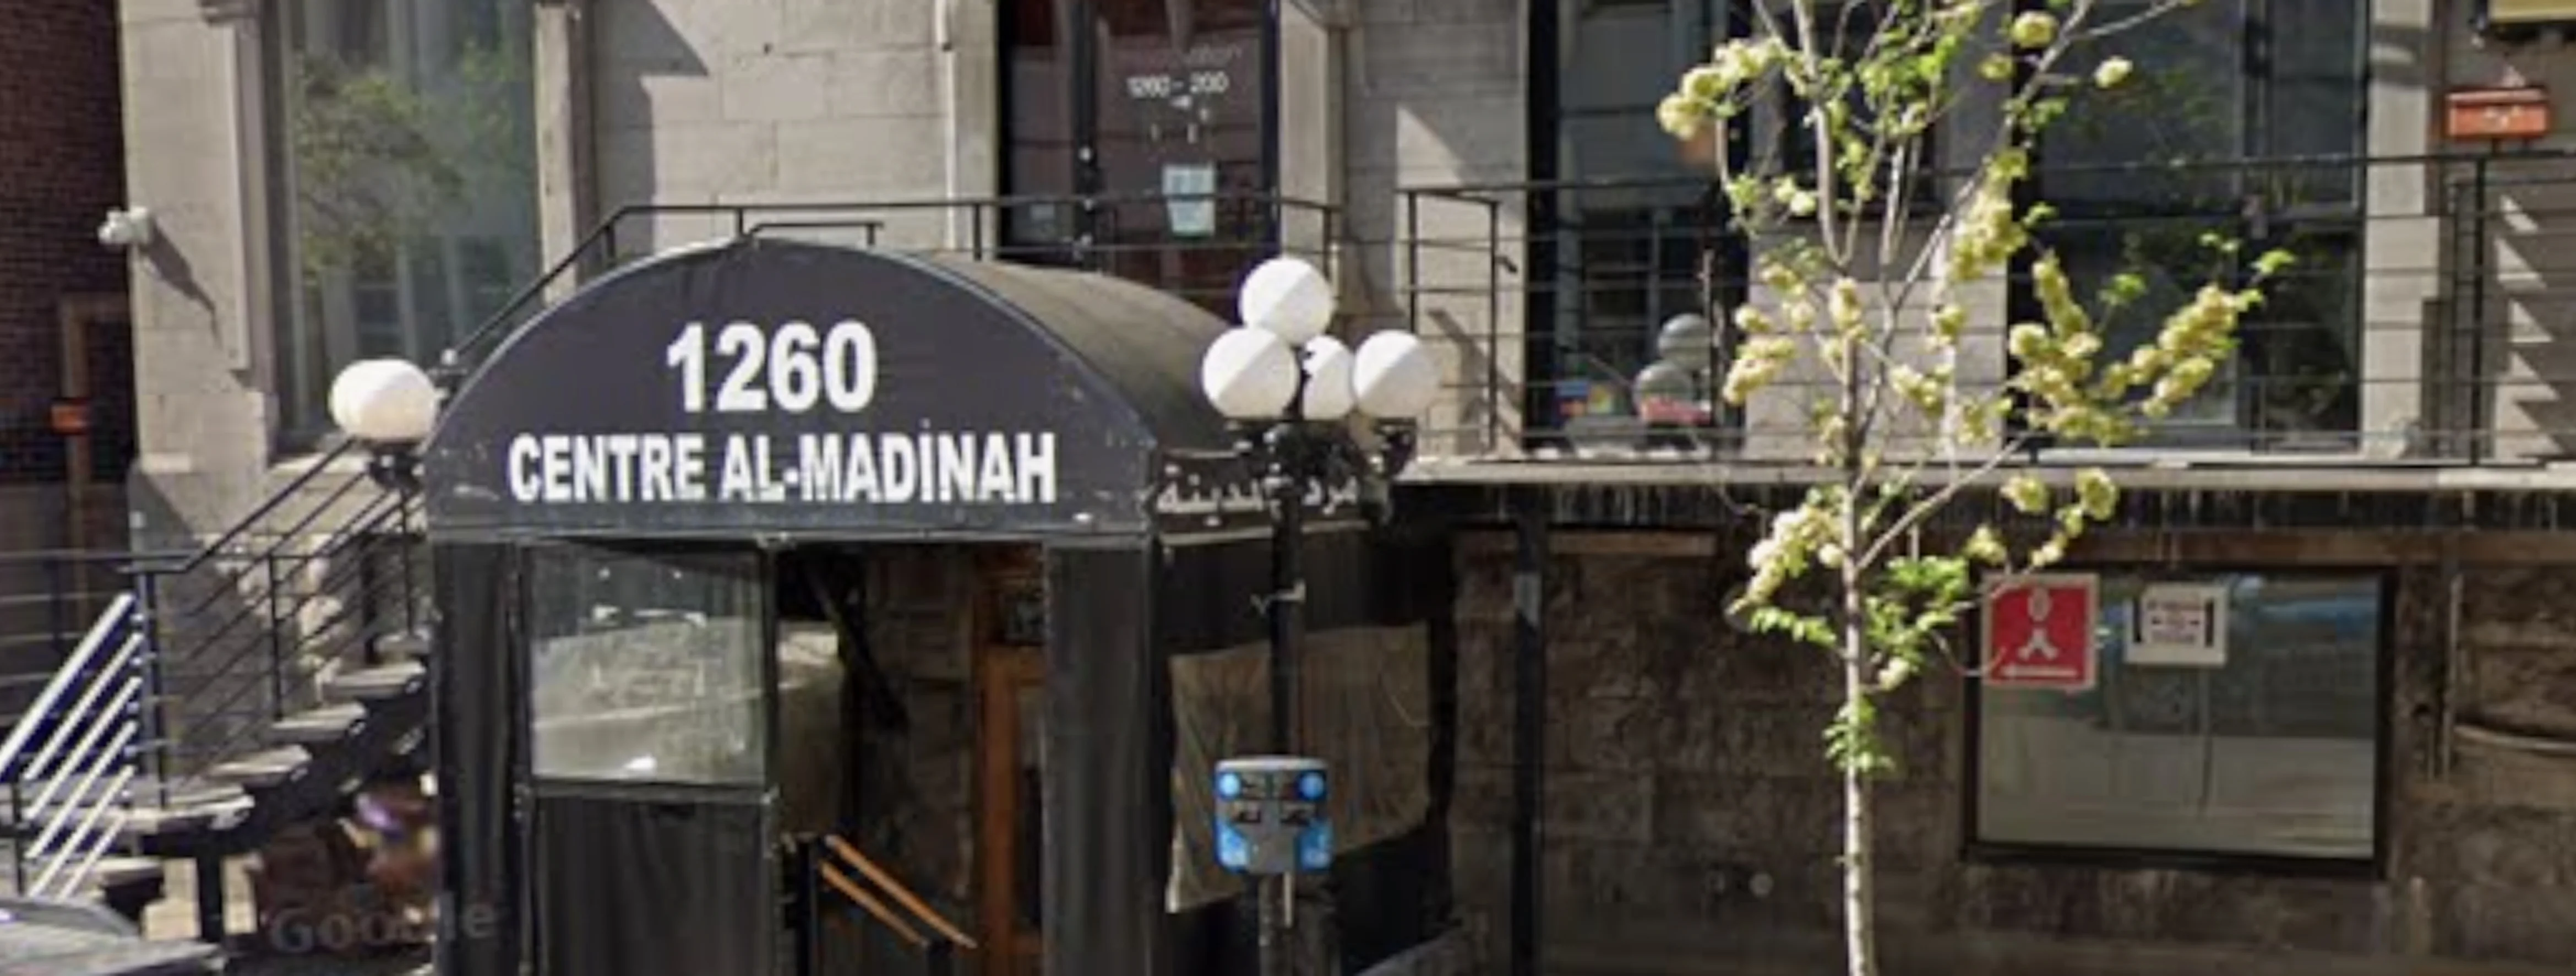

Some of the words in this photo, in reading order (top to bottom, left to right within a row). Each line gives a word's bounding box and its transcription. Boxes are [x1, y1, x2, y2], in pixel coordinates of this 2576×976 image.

[1188, 71, 1231, 94] 200
[666, 320, 877, 413] 1260
[508, 432, 706, 503] CENTRE
